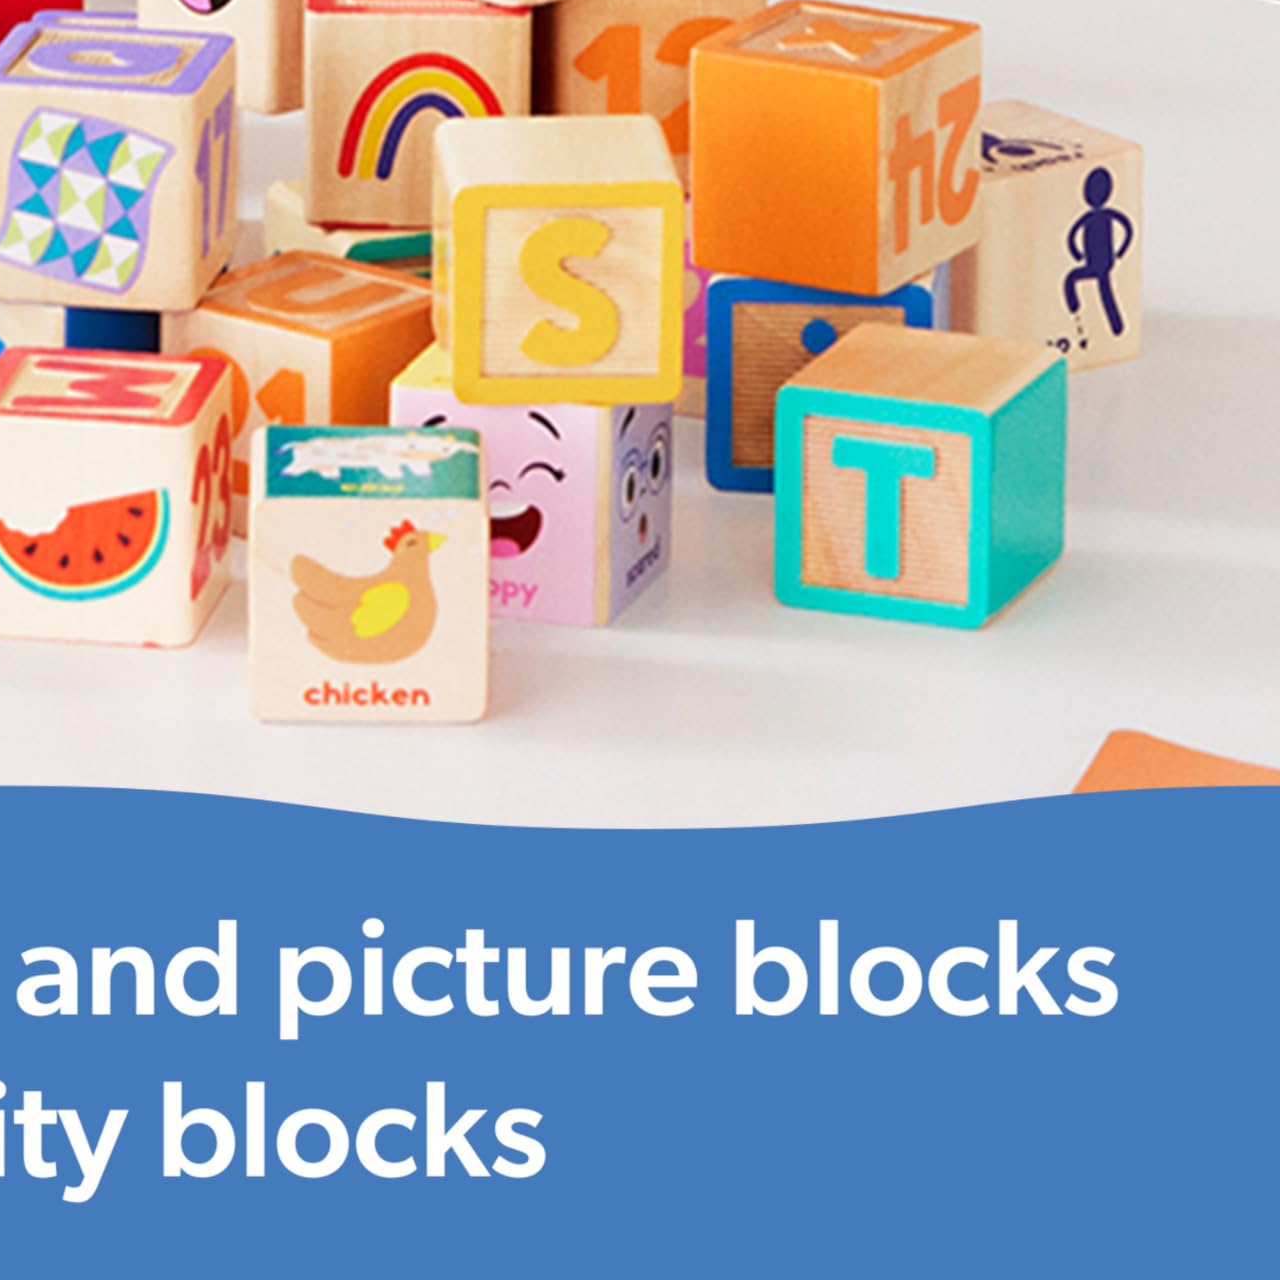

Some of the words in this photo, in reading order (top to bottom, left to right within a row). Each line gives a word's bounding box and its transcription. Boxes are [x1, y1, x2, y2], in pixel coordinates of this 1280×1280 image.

[28, 40, 184, 77] Q
[778, 23, 906, 60] X
[194, 88, 234, 261] 17
[888, 74, 982, 256] 24
[518, 216, 620, 367] S
[190, 412, 232, 602] 23
[832, 434, 935, 581] T
[303, 678, 432, 707] chicken
